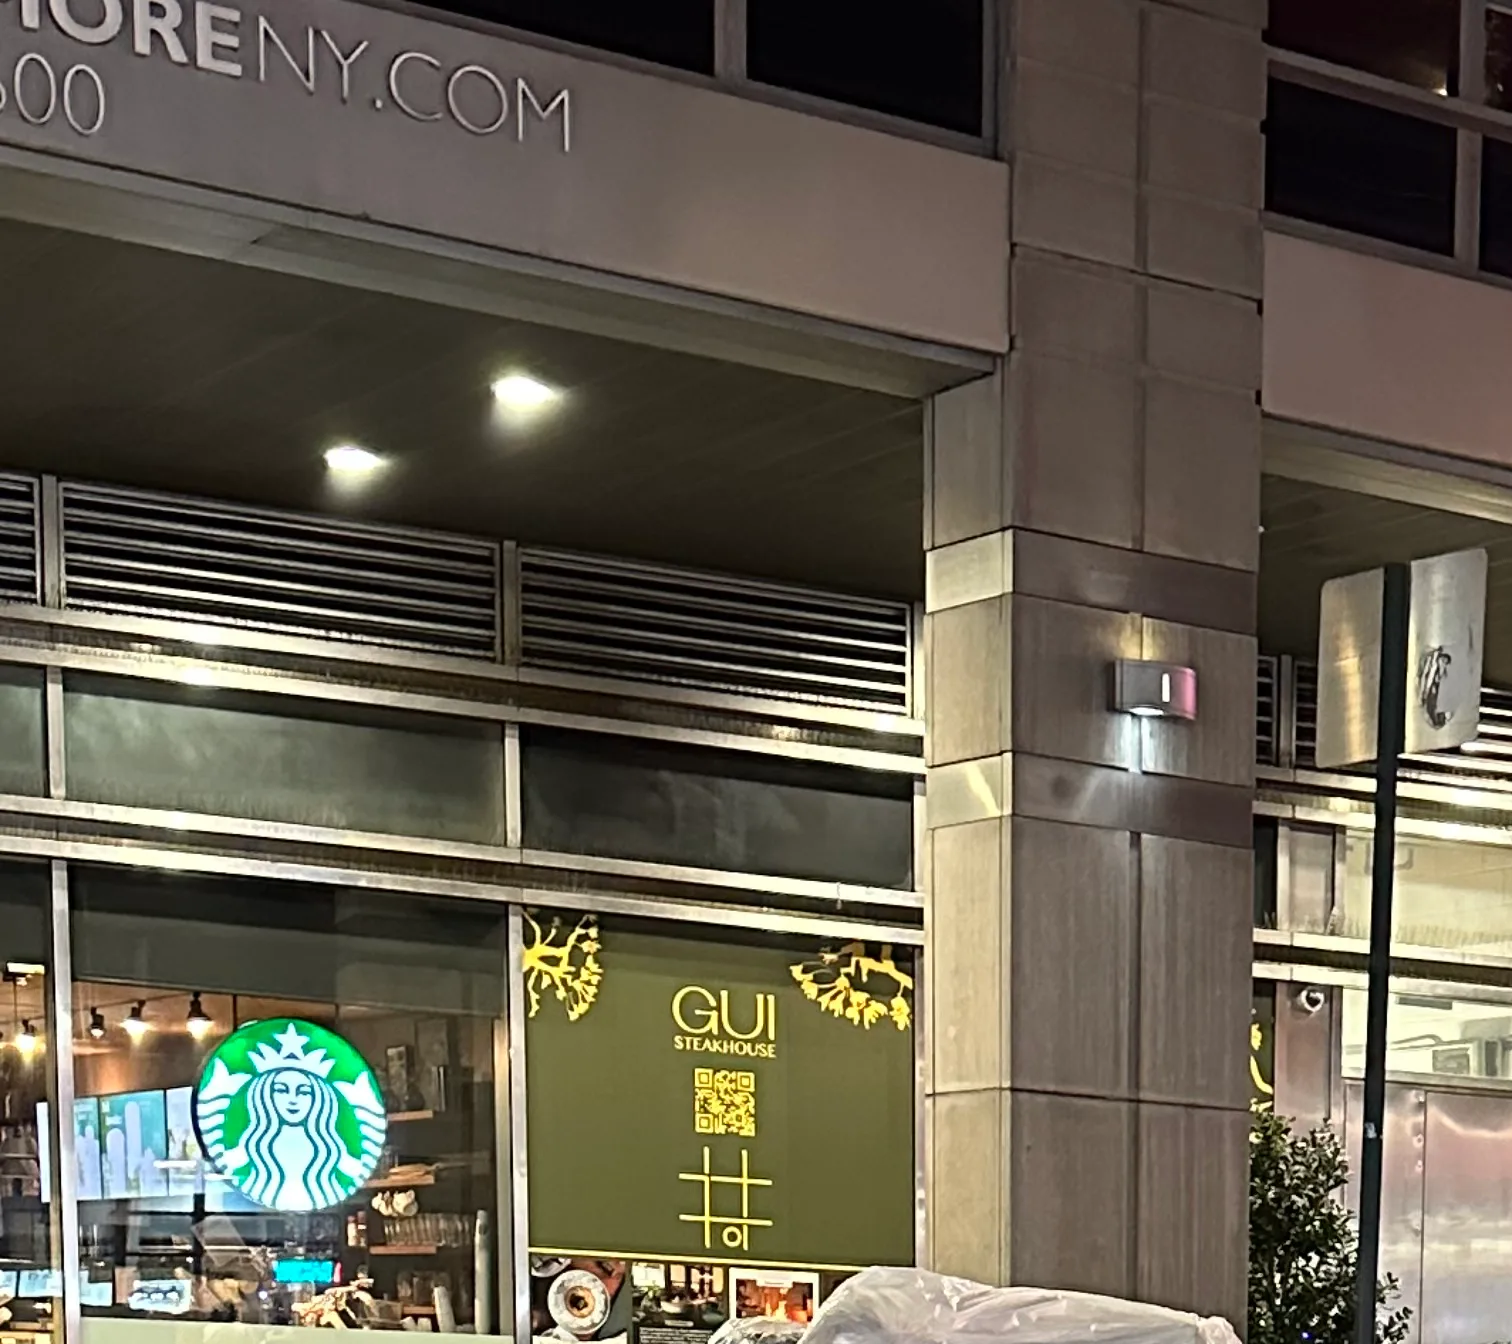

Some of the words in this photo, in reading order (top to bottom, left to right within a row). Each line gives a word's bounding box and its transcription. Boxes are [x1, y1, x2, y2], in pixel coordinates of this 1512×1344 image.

[0, 53, 105, 135] 00
[672, 985, 776, 1041] GUI
[673, 1035, 777, 1058] STEAKHOUSE
